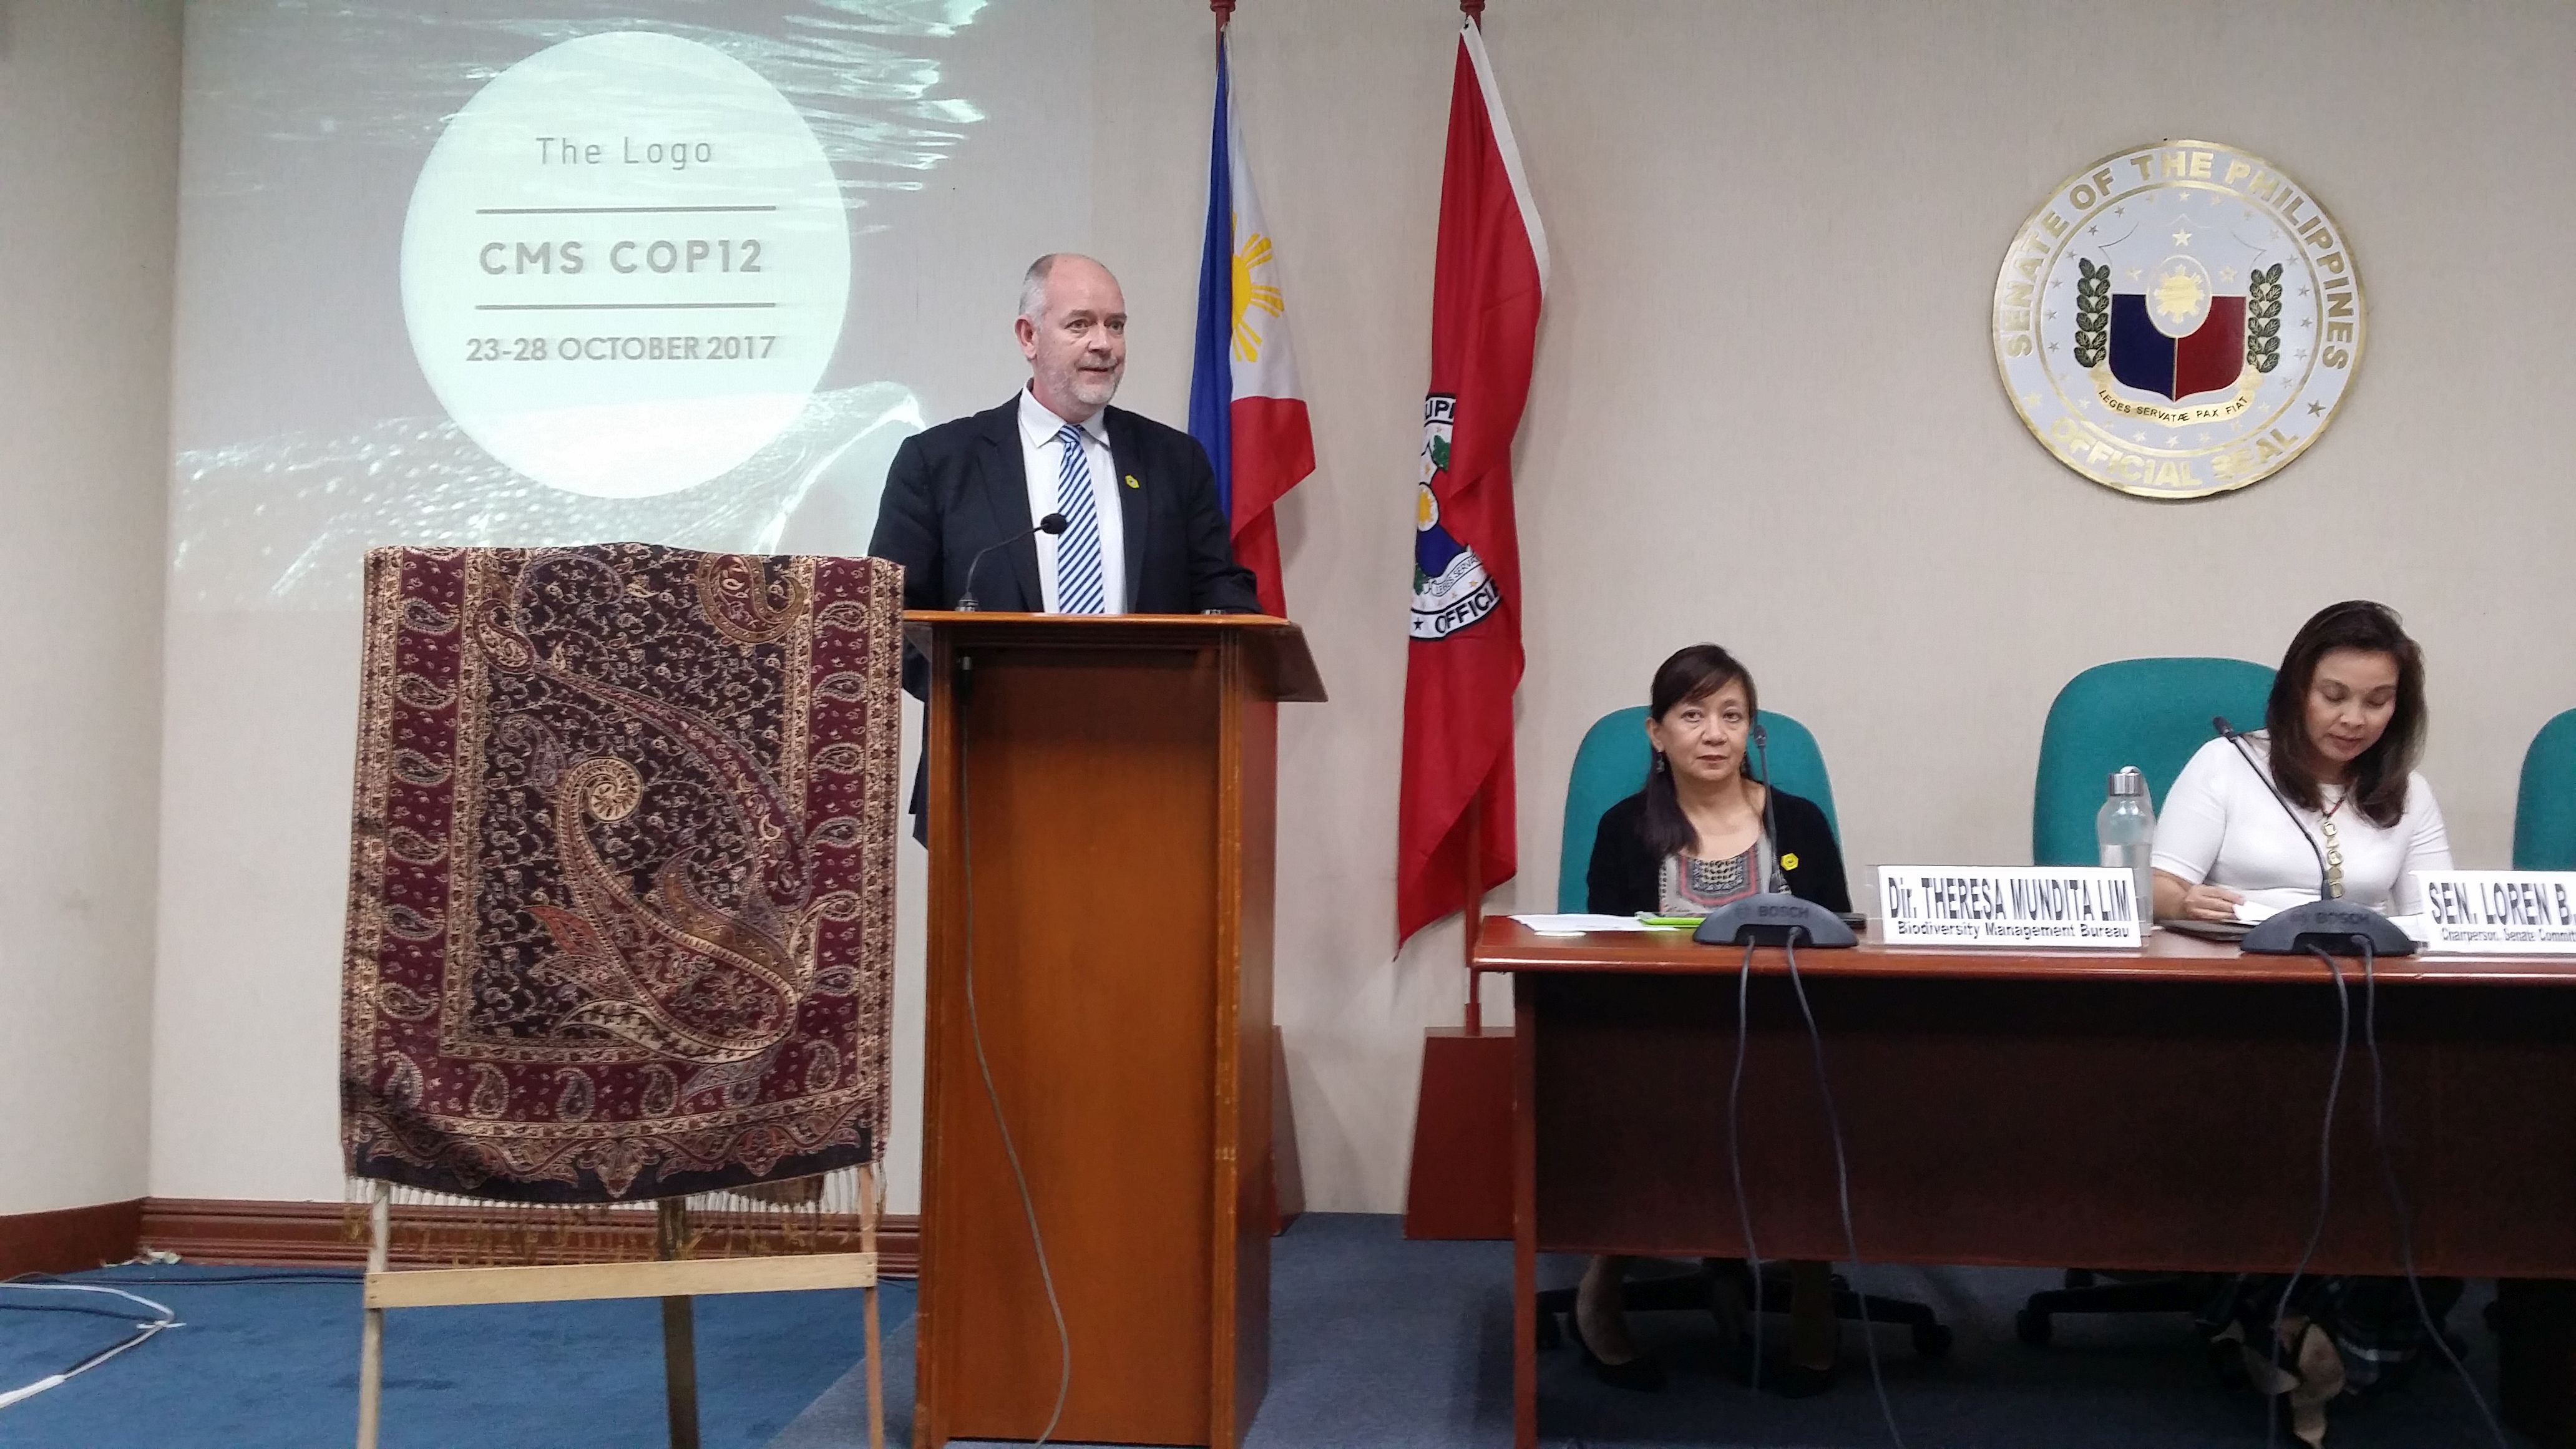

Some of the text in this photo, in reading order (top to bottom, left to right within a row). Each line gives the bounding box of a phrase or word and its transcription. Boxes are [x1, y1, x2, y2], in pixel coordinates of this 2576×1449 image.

[536, 136, 713, 170] The Logo
[479, 239, 762, 275] CMS COP12
[2006, 151, 2356, 371] SENATE OF THE PHILIPPINES
[466, 336, 777, 362] 23-28 OCTOBER 2017
[2099, 389, 2131, 414] LEGES
[2197, 409, 2219, 418] PAX
[2226, 396, 2248, 415] FIAT
[2051, 416, 2299, 487] OFFICIAL SEAL
[1453, 555, 1481, 578] SERVA
[1888, 877, 2132, 922] Dir. THERESA MUNDITA LIM
[2429, 882, 2478, 924] SEN.
[2481, 882, 2552, 925] LOREN
[1898, 921, 2130, 940] Biodiversity Management Bureau
[2504, 928, 2535, 941] Senate
